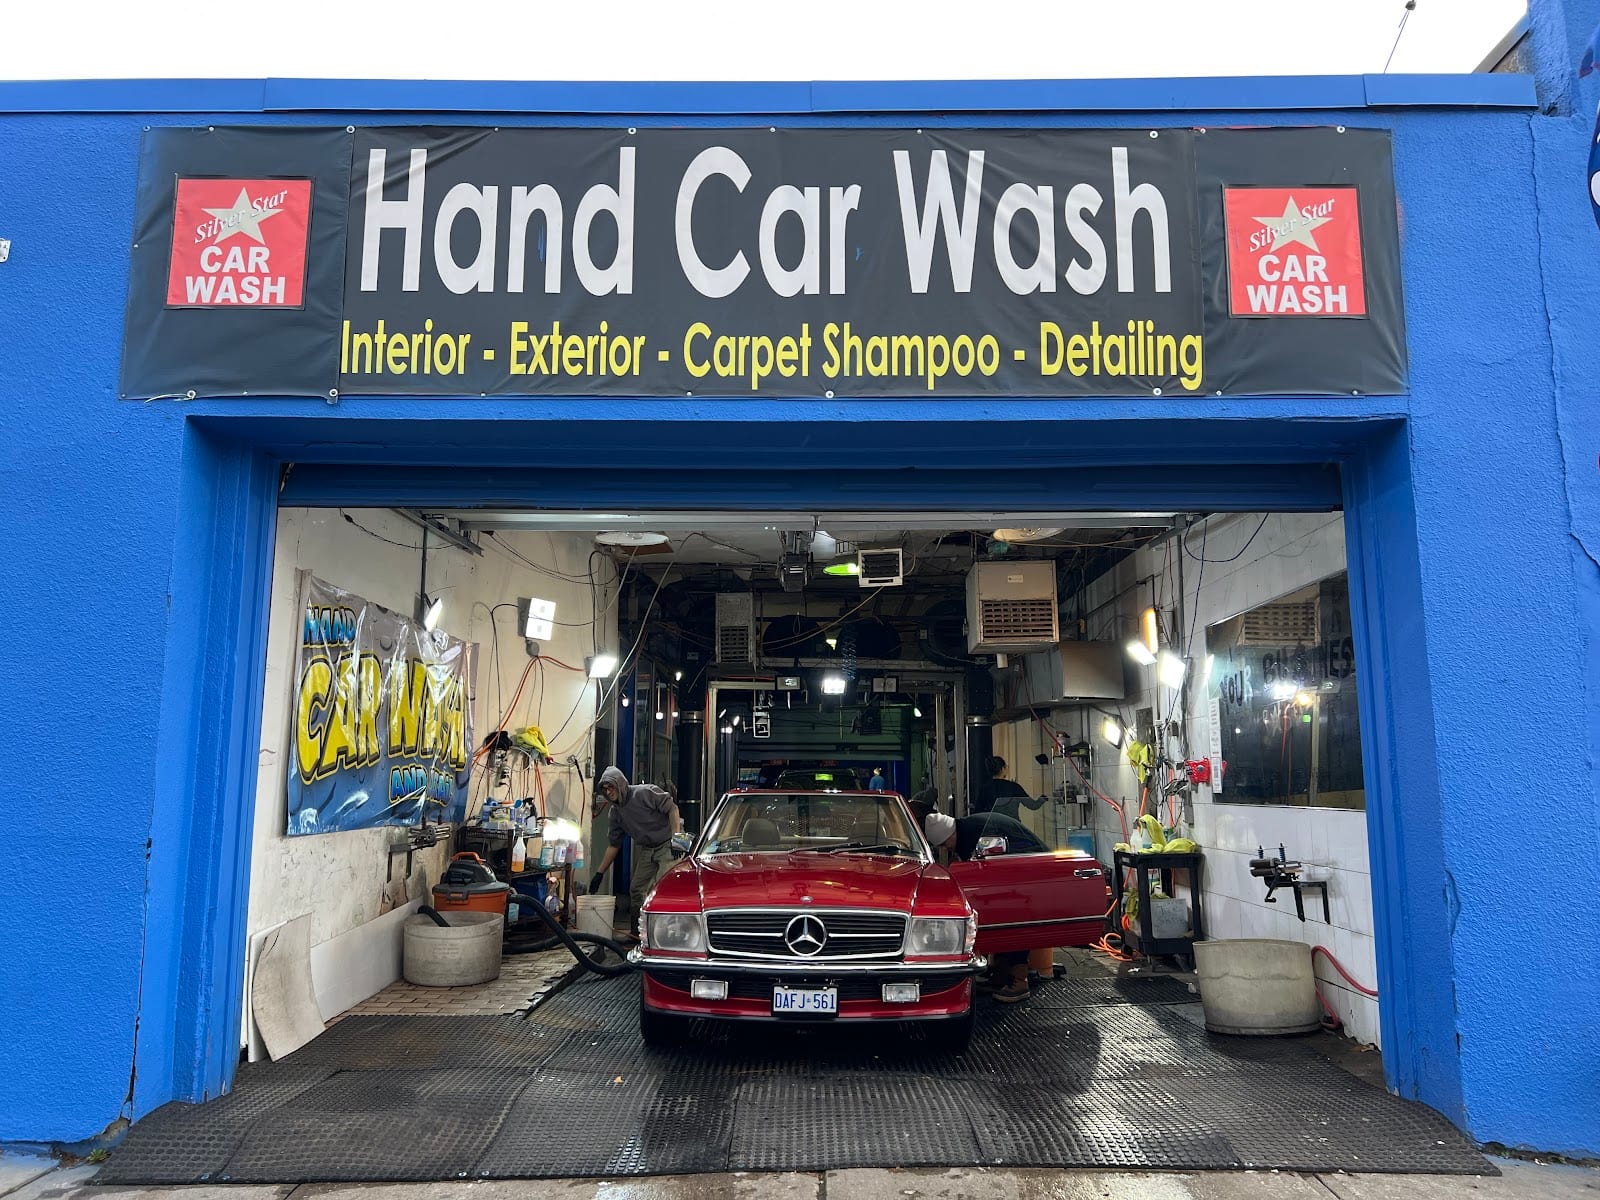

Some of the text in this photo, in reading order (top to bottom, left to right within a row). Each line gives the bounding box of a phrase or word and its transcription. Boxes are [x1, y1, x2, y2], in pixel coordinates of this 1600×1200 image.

[194, 189, 288, 244] Silver Star
[360, 146, 1172, 299] Hand Car Wash
[1249, 198, 1335, 252] Silver Star
[200, 245, 270, 273] CAR
[1258, 254, 1329, 282] CAR
[185, 276, 286, 304] WASH
[1246, 284, 1348, 313] WASH
[341, 319, 472, 375] Interior
[510, 321, 647, 376] Exterior
[684, 323, 812, 389] Carpet
[823, 323, 1000, 389] Shampoo
[1040, 319, 1204, 391] Detailing
[297, 653, 382, 784] CAR
[389, 764, 428, 803] AND
[774, 992, 836, 1009] DAFJ 561
